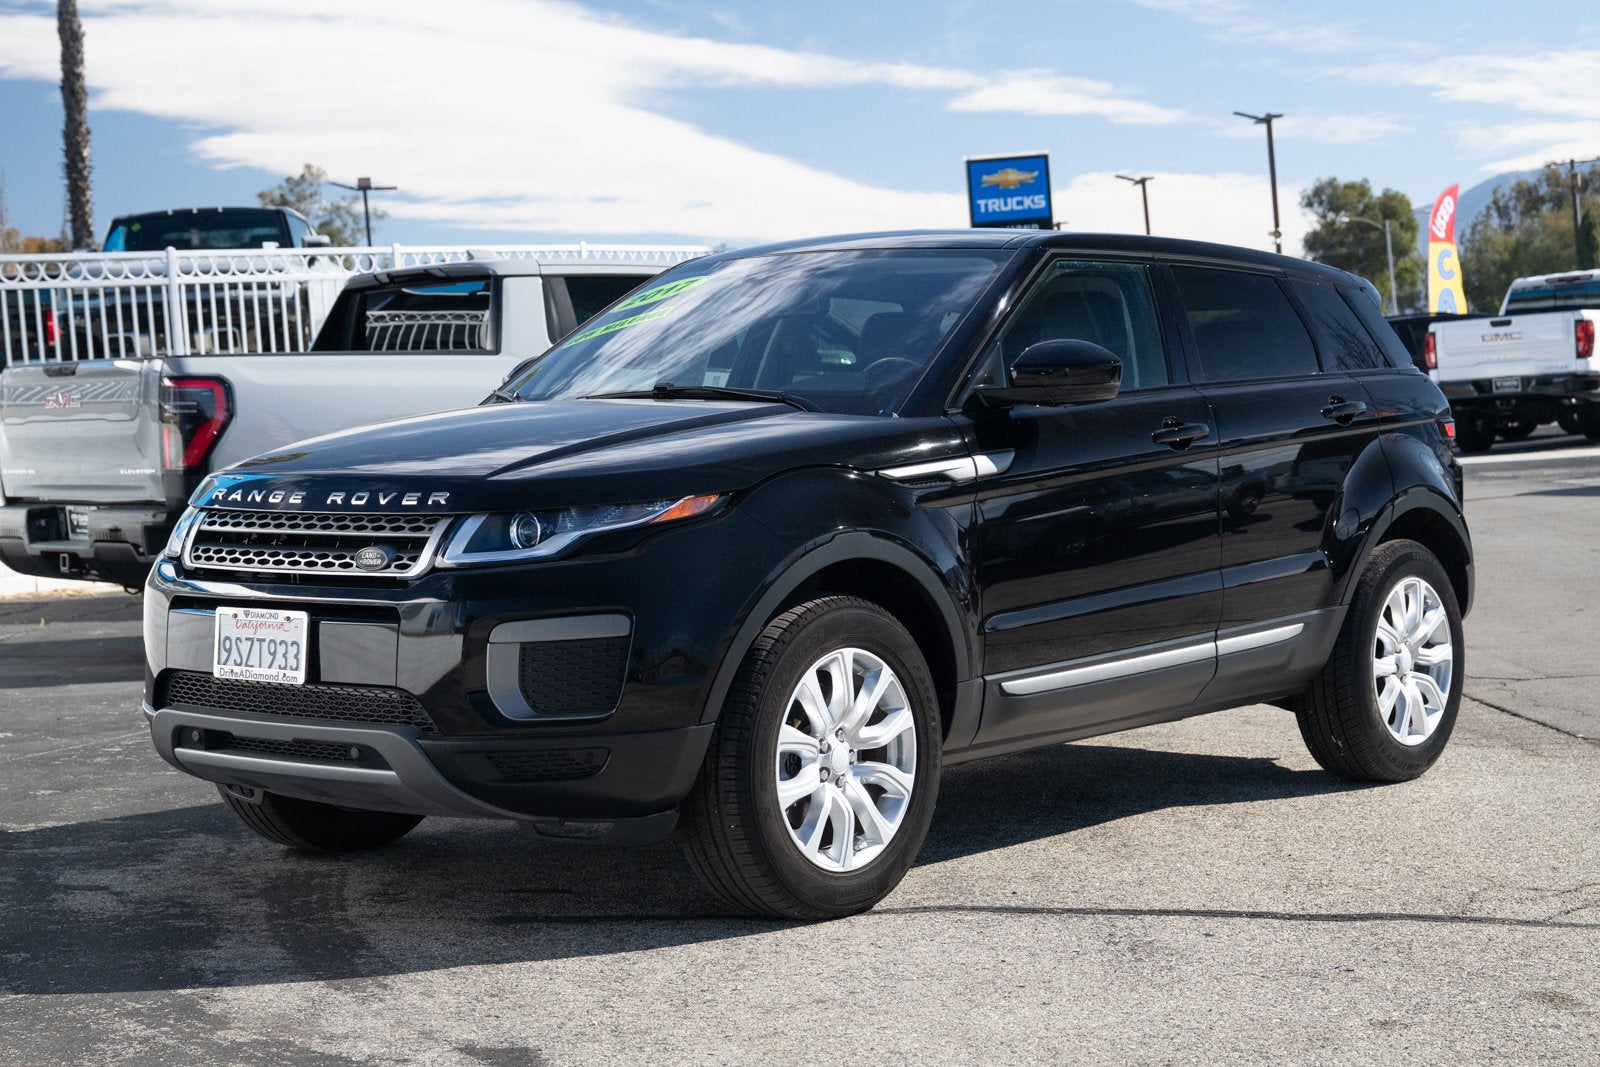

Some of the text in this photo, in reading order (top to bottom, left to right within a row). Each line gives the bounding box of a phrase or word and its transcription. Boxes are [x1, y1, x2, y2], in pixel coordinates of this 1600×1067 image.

[977, 194, 1046, 213] TRUCKS
[1431, 194, 1455, 239] USED
[618, 278, 702, 310] 2017
[1481, 332, 1523, 343] GMC
[44, 393, 81, 408] GMC
[212, 488, 451, 506] RANGE ROVER
[250, 611, 279, 620] DIAMOND
[234, 618, 291, 635] California
[222, 635, 300, 671] 9SZT933
[219, 667, 298, 683] DriveADiamond.com
